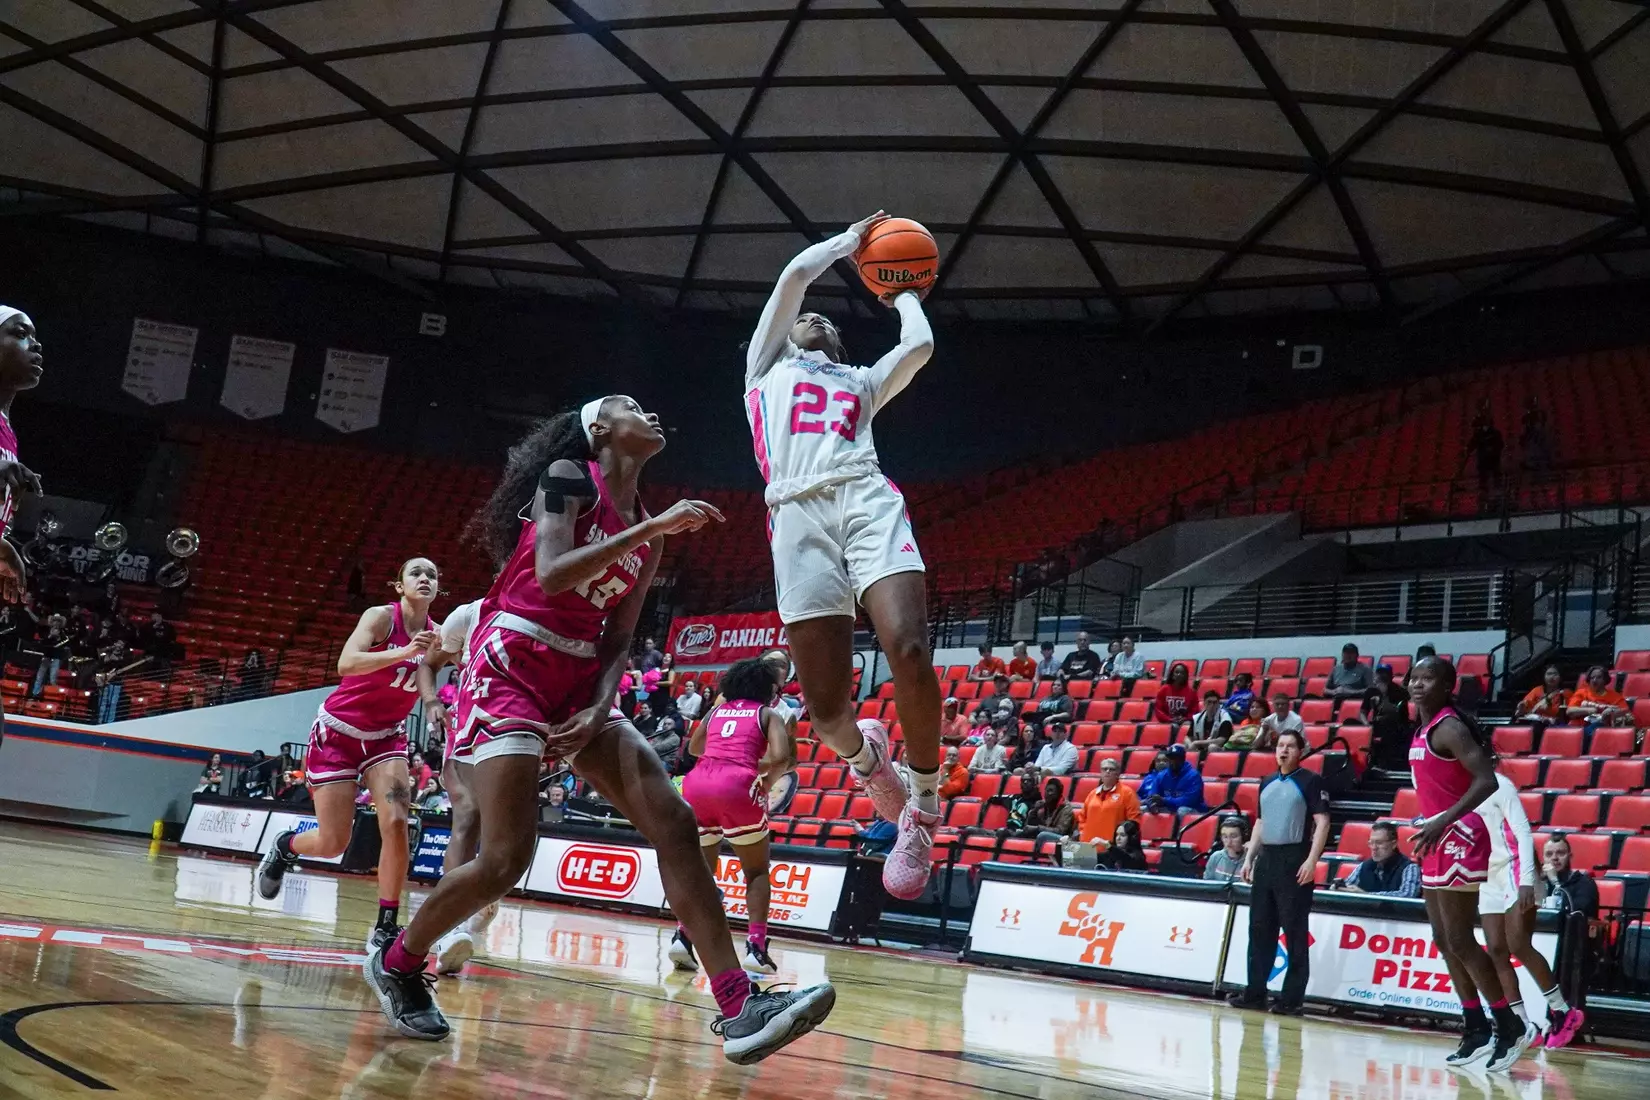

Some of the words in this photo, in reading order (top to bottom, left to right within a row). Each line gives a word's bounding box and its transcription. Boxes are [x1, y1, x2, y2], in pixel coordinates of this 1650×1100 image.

[877, 267, 932, 283] Wilson
[418, 312, 447, 336] B
[1292, 344, 1322, 369] D
[790, 381, 861, 442] 23
[575, 568, 628, 609] 15
[720, 628, 776, 648] CANIAC
[715, 708, 756, 718] BEARKATS
[721, 720, 737, 738] 0
[1372, 959, 1453, 994] Pizz
[1348, 987, 1377, 1001] Order
[1379, 991, 1412, 1005] Online
